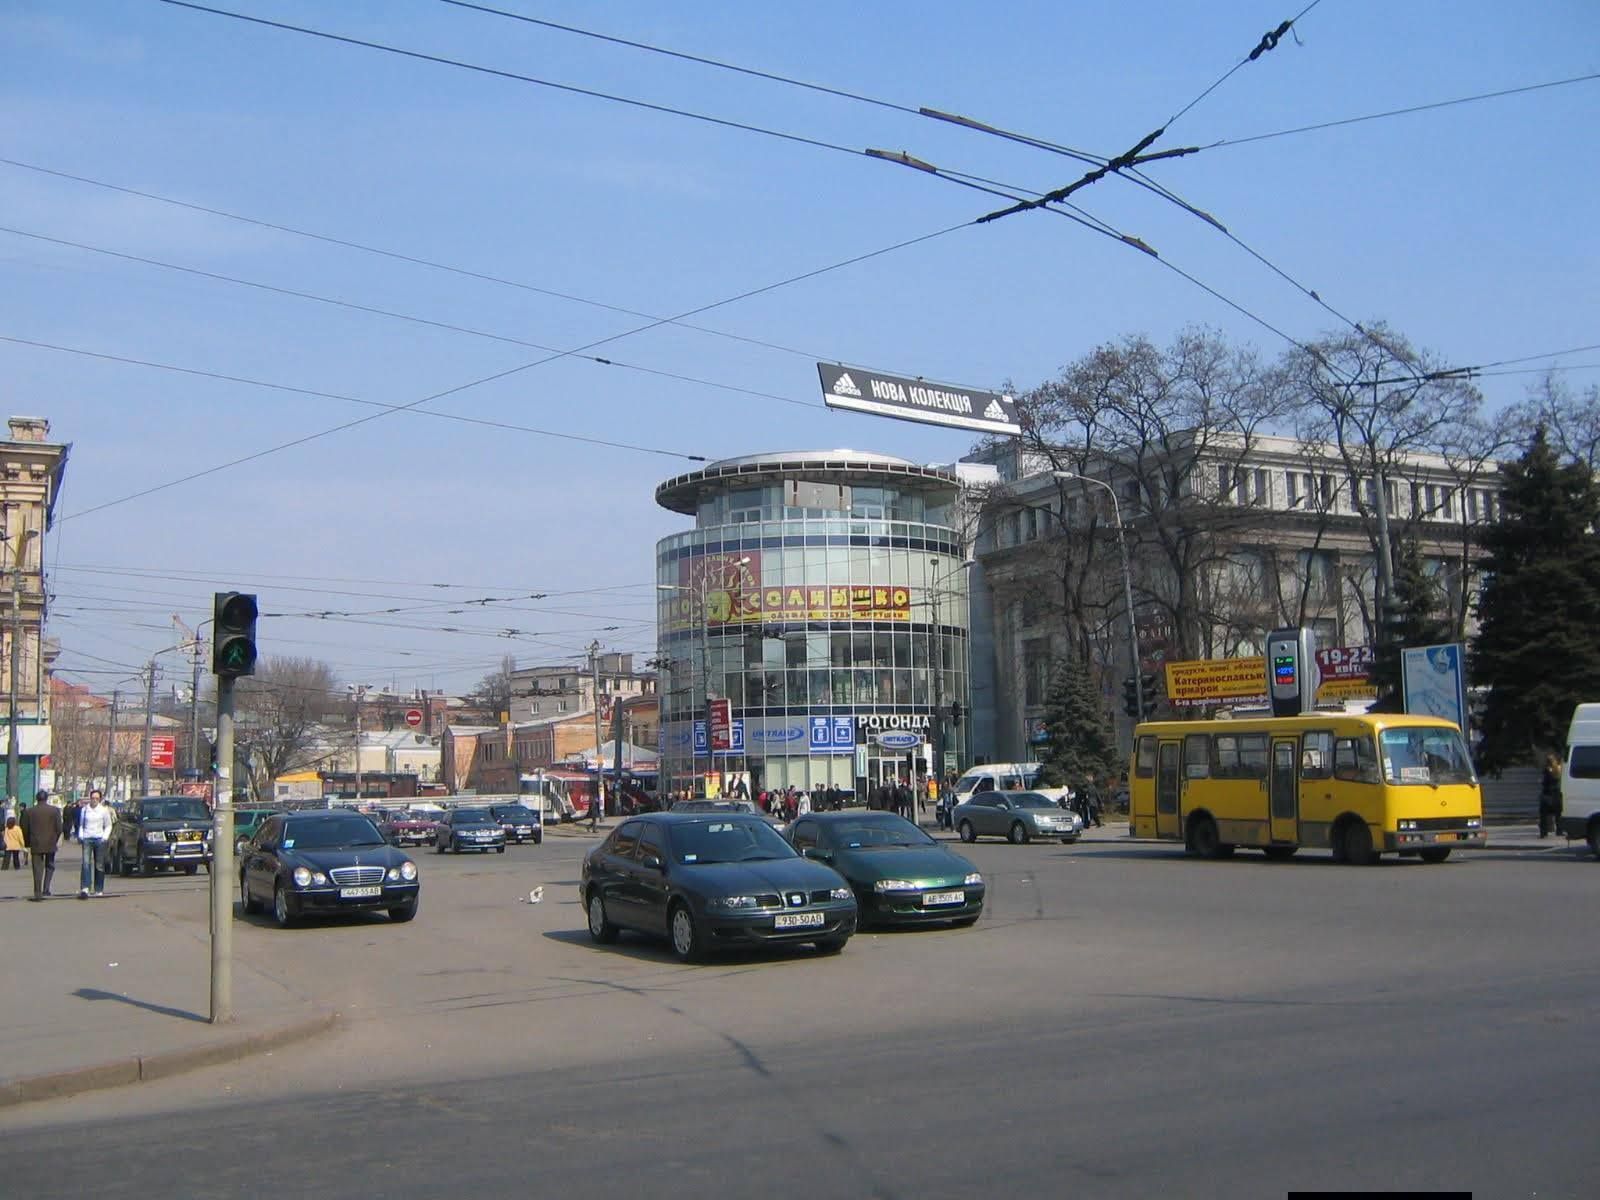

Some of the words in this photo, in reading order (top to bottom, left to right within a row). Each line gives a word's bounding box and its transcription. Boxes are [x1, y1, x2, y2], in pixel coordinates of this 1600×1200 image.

[871, 379, 907, 402] НОВА
[909, 386, 973, 415] КОЛЕКЦІЯ
[749, 588, 907, 608] СОЛНЫШКО
[858, 715, 931, 729] РОТОНДА
